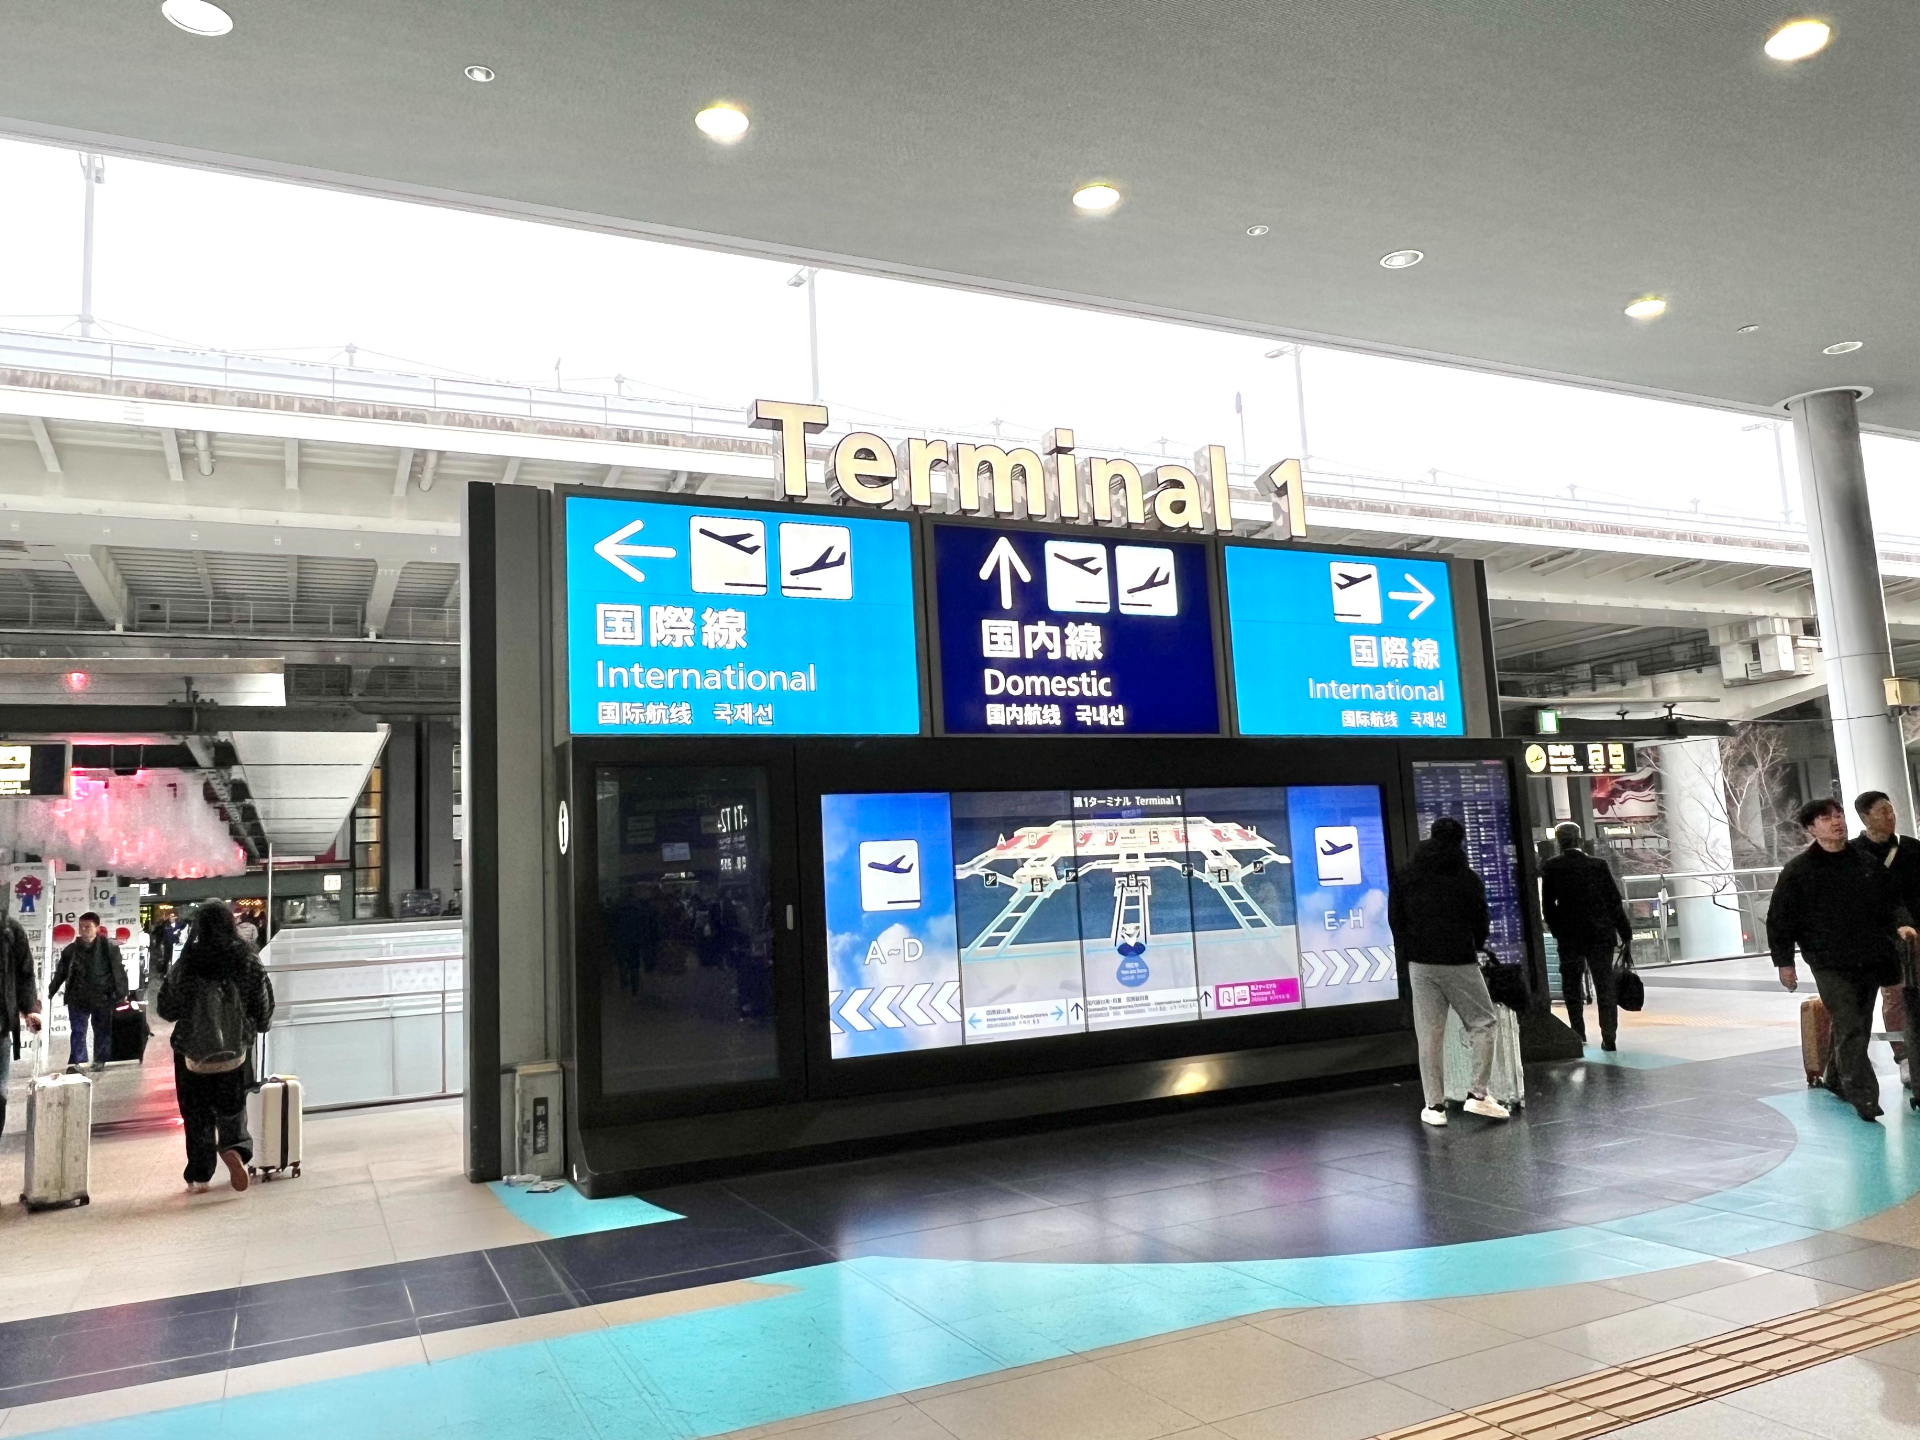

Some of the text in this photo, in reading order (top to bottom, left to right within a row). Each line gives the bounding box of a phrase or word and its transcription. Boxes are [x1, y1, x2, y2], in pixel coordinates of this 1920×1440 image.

[748, 399, 1308, 538] Terminal 1
[595, 603, 749, 651] 国際線
[981, 619, 1104, 661] 国内線
[1350, 635, 1440, 670] 国際線
[596, 660, 817, 693] International
[984, 668, 1112, 697] Domestic
[1308, 677, 1445, 702] International
[598, 702, 775, 726] 国际航线 국제선
[986, 703, 1125, 726] 国内航线 국내선
[1341, 710, 1447, 729] 国际航线 국제선
[1135, 795, 1174, 806] Terminal
[1176, 795, 1182, 806] 1
[997, 833, 1007, 847] A
[1028, 832, 1038, 846] B
[1106, 829, 1116, 844] D
[1149, 828, 1159, 843] E
